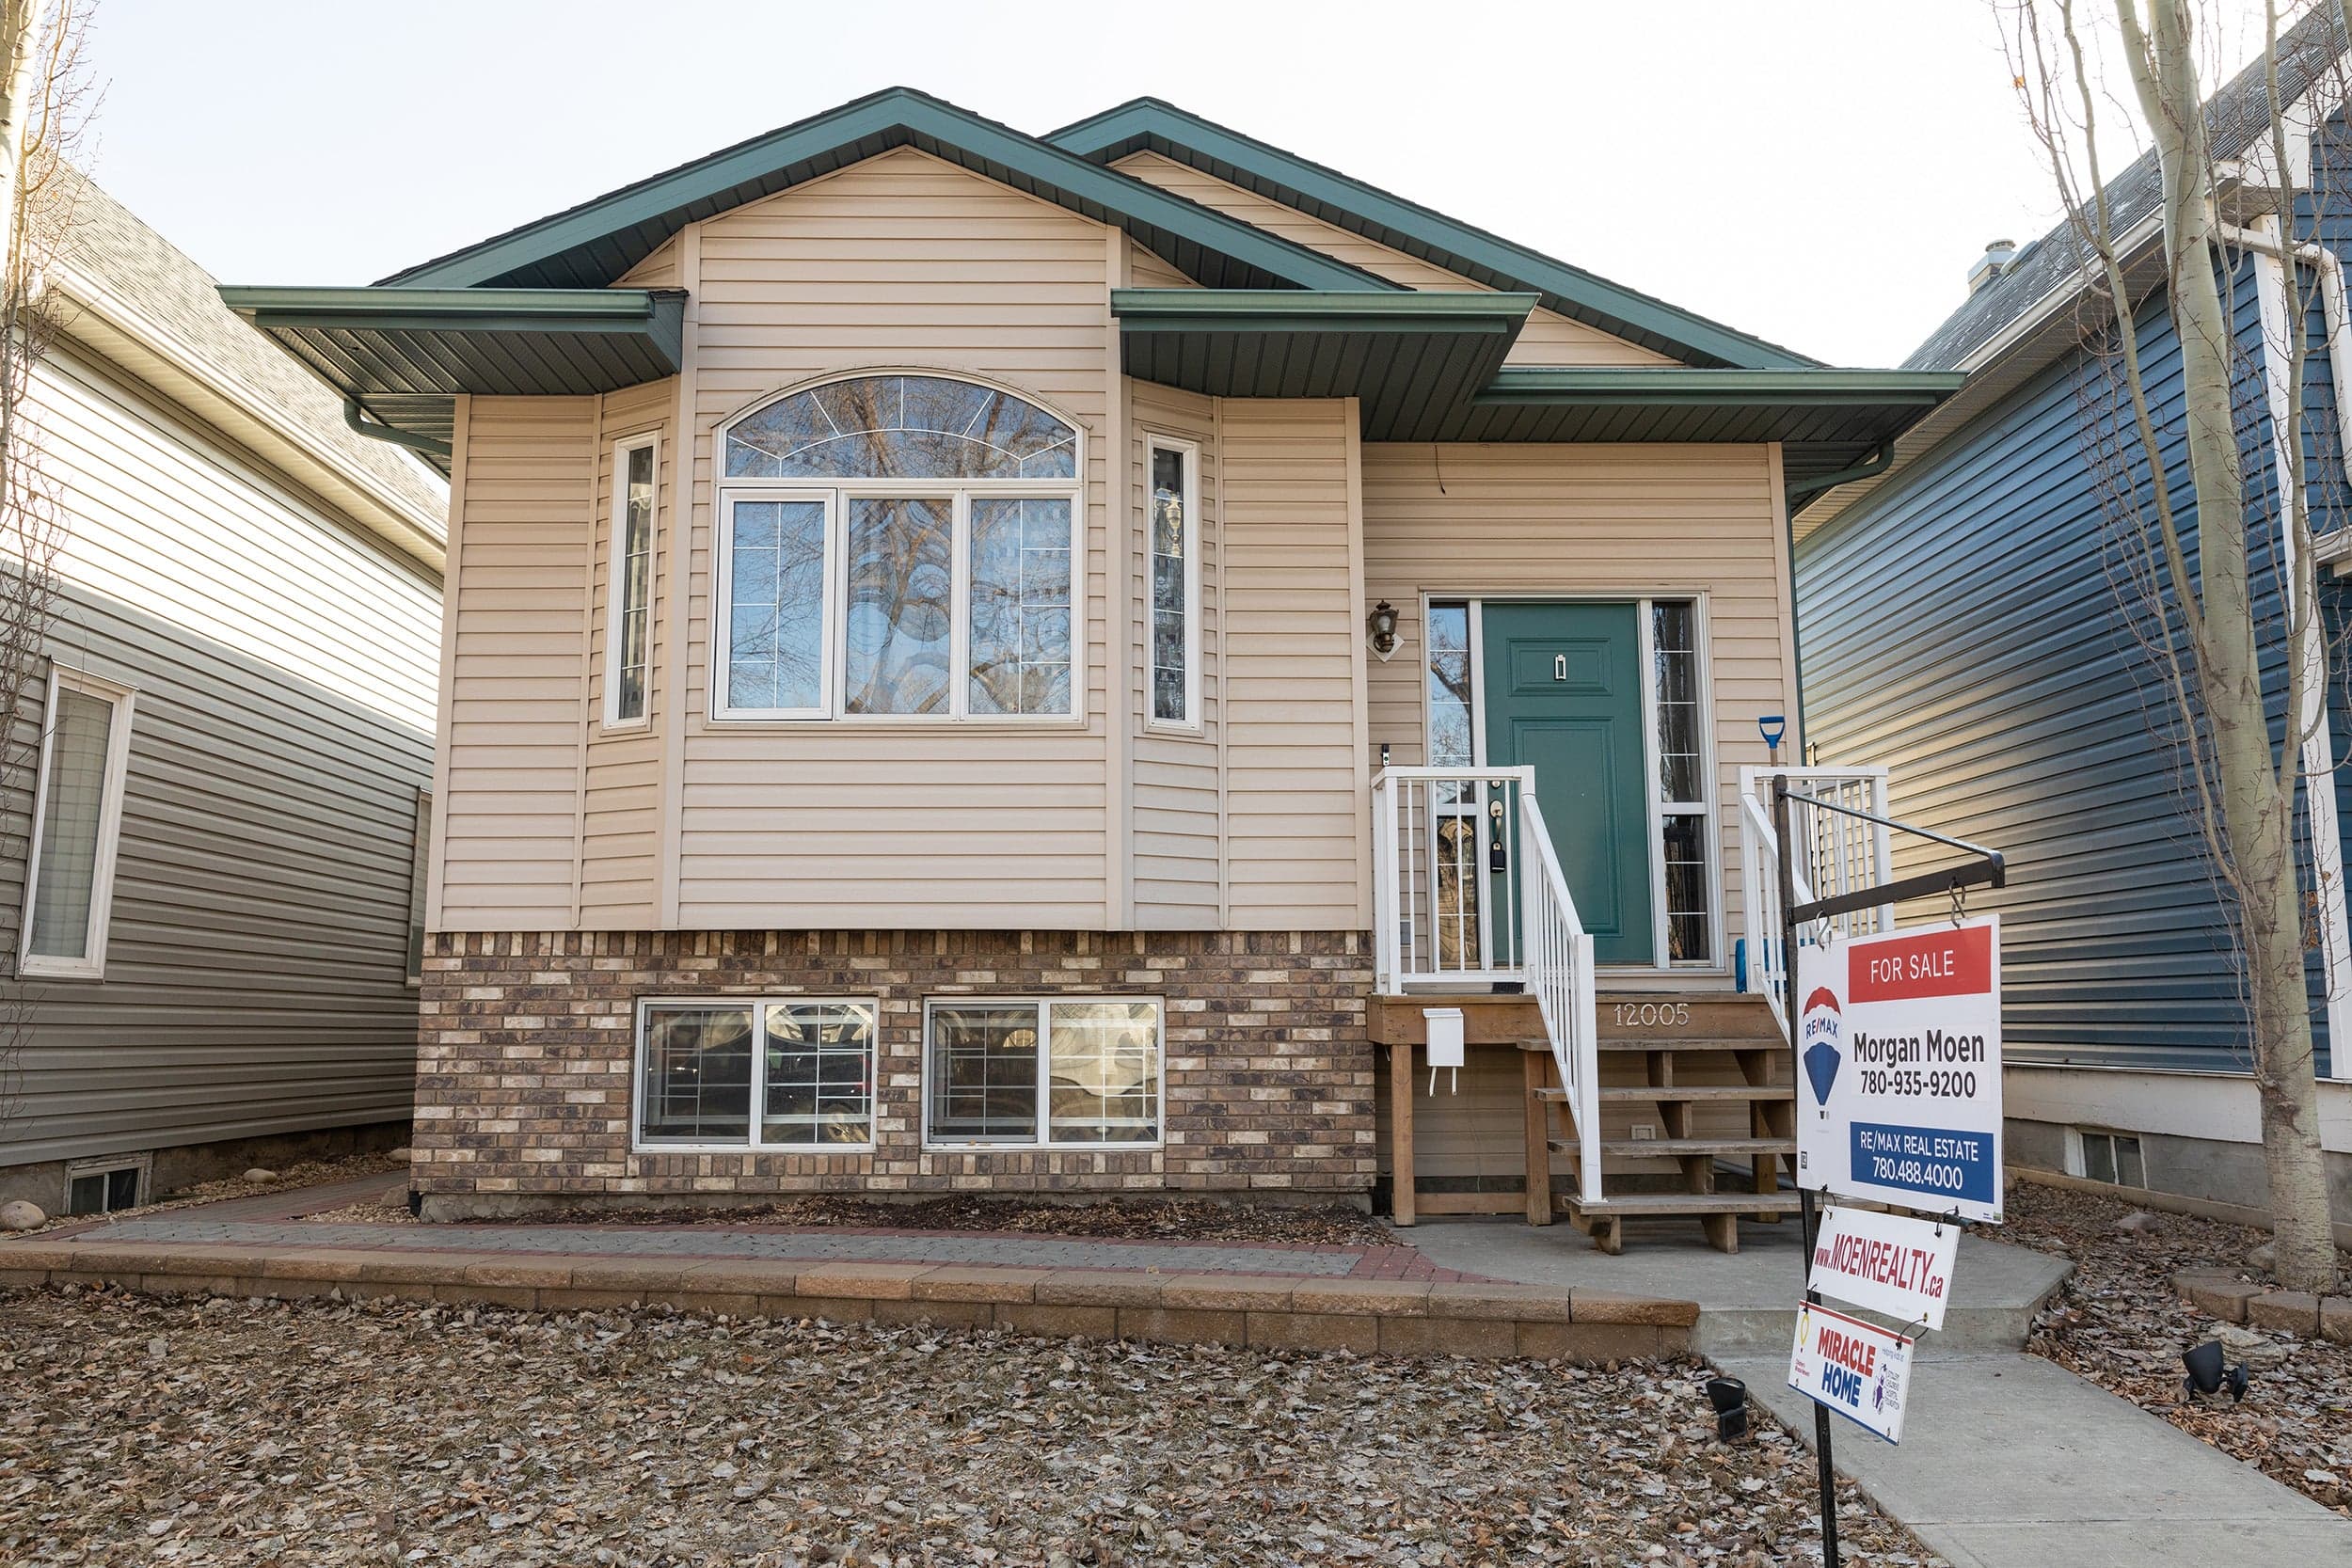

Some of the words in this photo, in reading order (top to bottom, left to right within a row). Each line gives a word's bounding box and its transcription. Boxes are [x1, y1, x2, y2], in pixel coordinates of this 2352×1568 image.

[1870, 957, 1902, 984] FOR
[1909, 950, 1954, 980] SALE
[1613, 1003, 1690, 1027] 12005
[1805, 1017, 1837, 1039] RE/MAX
[1853, 1032, 1920, 1069] Morgan
[1926, 1029, 1985, 1063] Moen
[1860, 1069, 1977, 1099] 780-935-9200
[1860, 1130, 1901, 1152] RE/MAX
[1903, 1134, 1931, 1157] REAL
[1934, 1137, 1979, 1162] ESTATE
[1872, 1156, 1963, 1191] 780.488.4000
[1814, 1233, 1944, 1299] www.MOENREALTY.ca
[1817, 1326, 1877, 1378] MIRACLE
[1821, 1361, 1863, 1408] HOME
